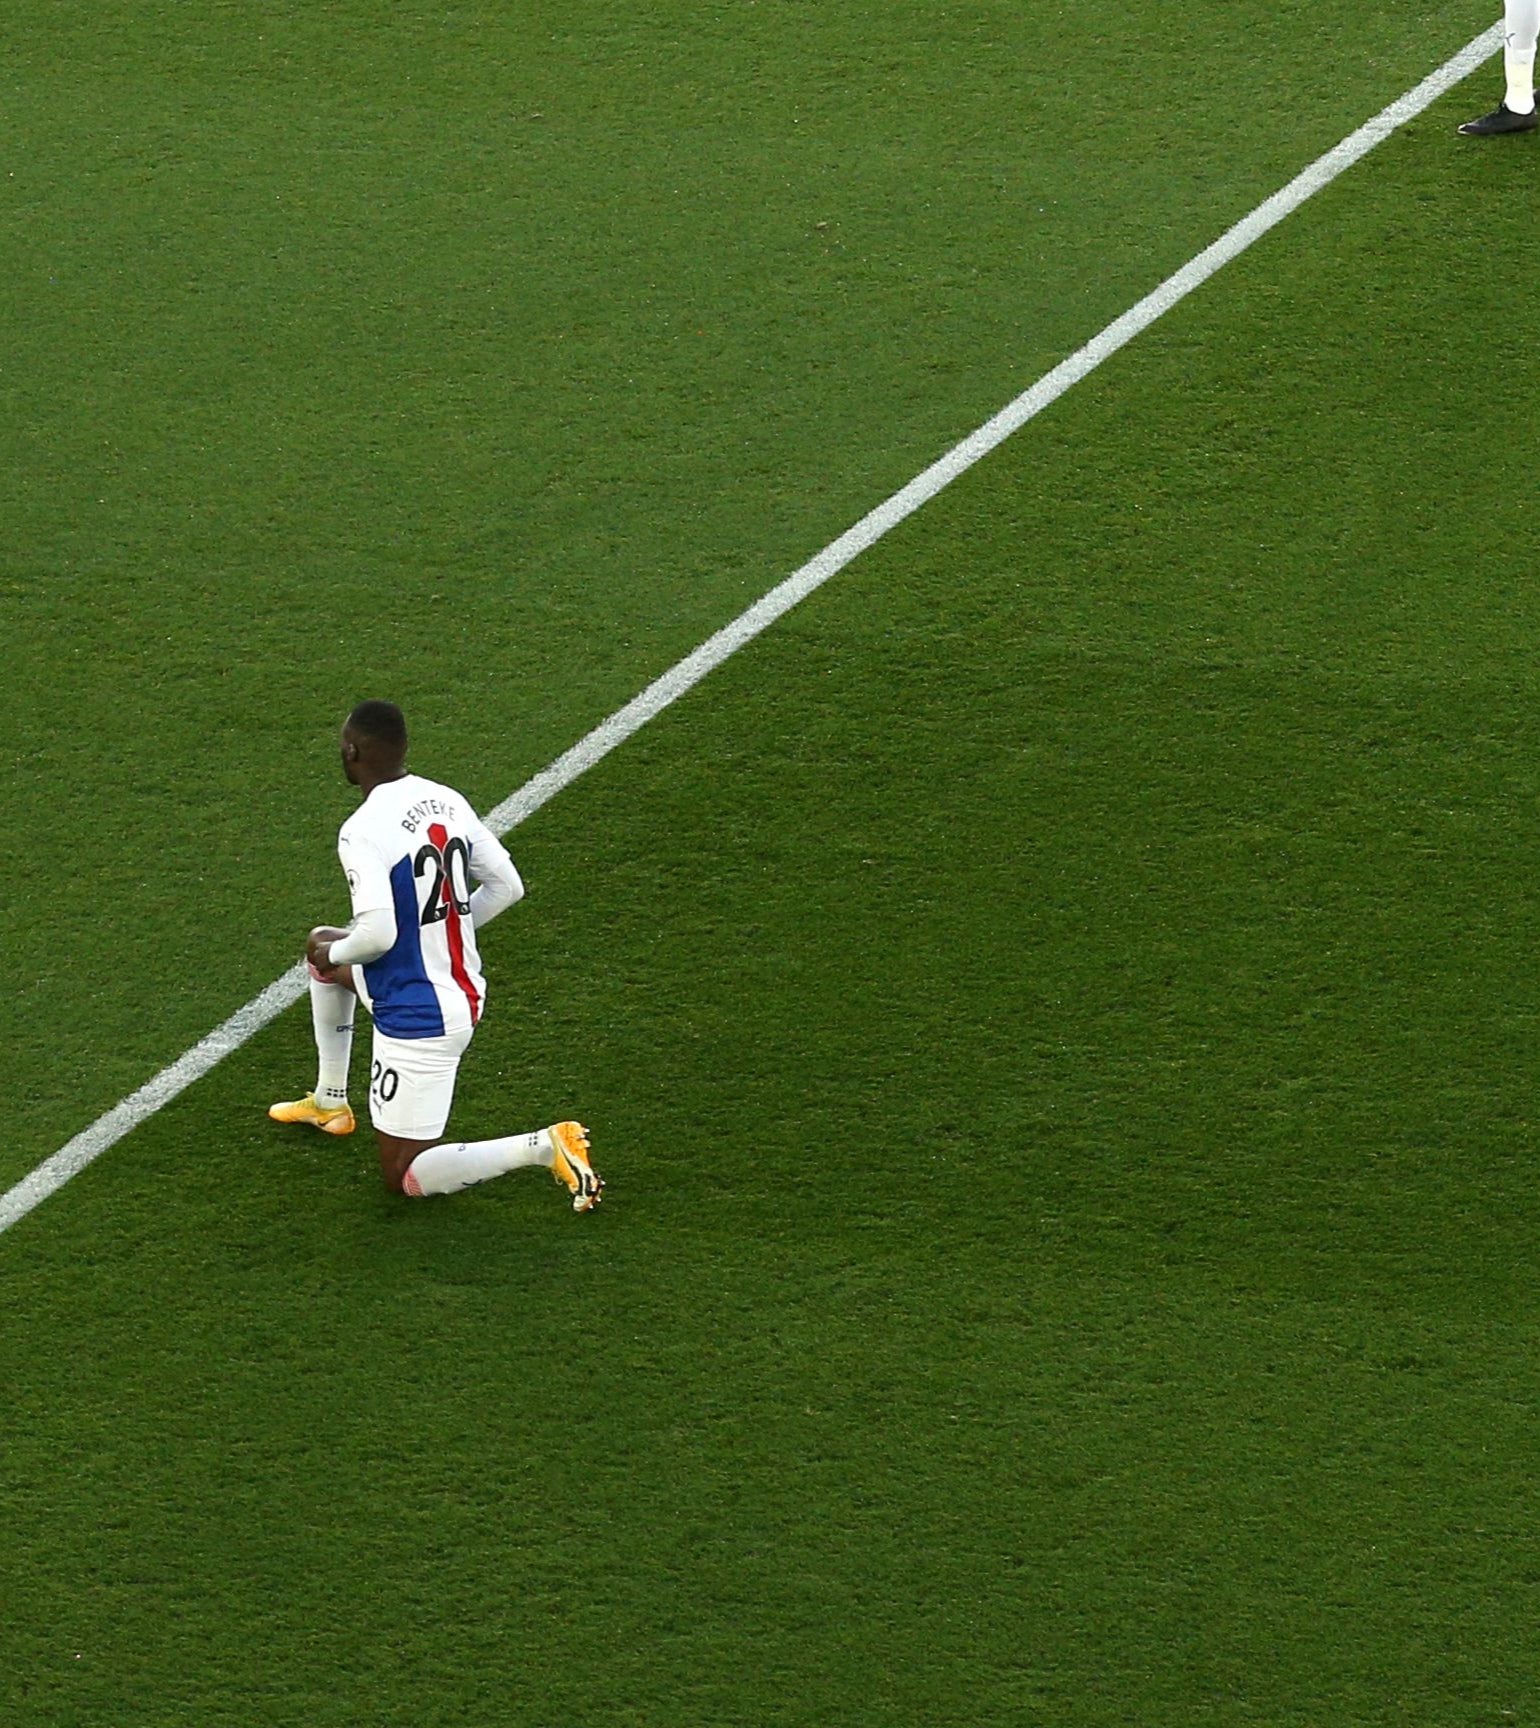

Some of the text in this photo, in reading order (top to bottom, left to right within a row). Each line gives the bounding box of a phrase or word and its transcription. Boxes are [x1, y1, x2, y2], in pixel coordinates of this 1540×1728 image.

[400, 798, 456, 834] BENTEKE
[413, 836, 471, 926] 20
[371, 1058, 399, 1102] 20
